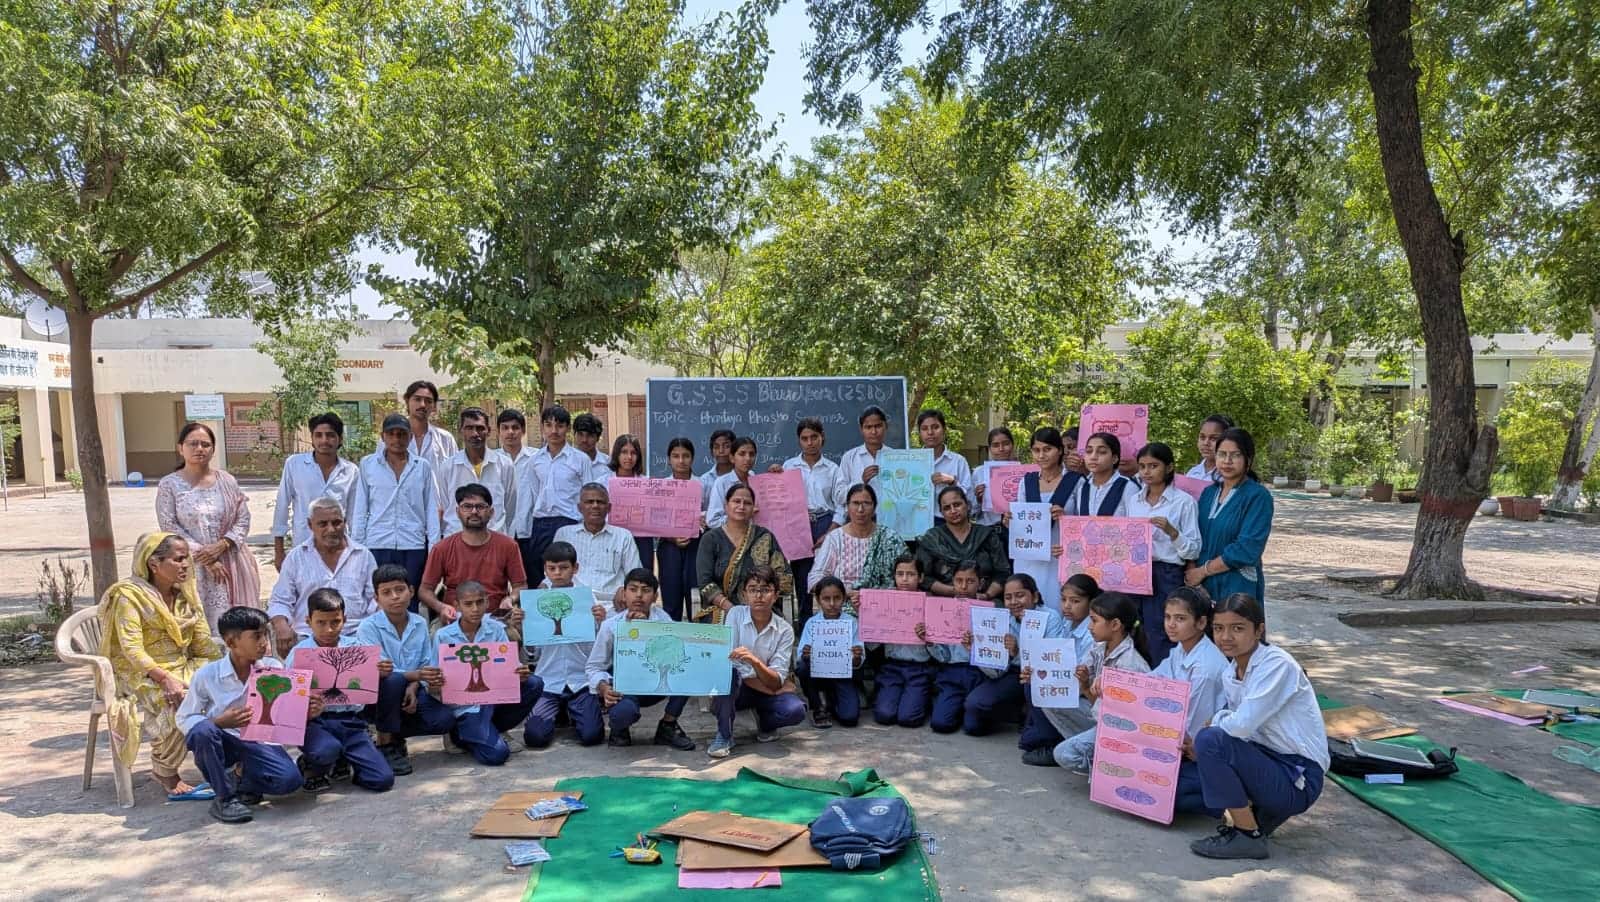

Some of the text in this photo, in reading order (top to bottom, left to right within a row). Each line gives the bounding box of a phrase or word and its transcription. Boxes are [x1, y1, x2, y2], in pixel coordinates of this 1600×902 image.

[823, 627, 845, 636] LOVE
[823, 639, 838, 647] MY
[817, 651, 844, 659] INDIA
[1041, 649, 1063, 664] आई
[1051, 670, 1072, 679] माय
